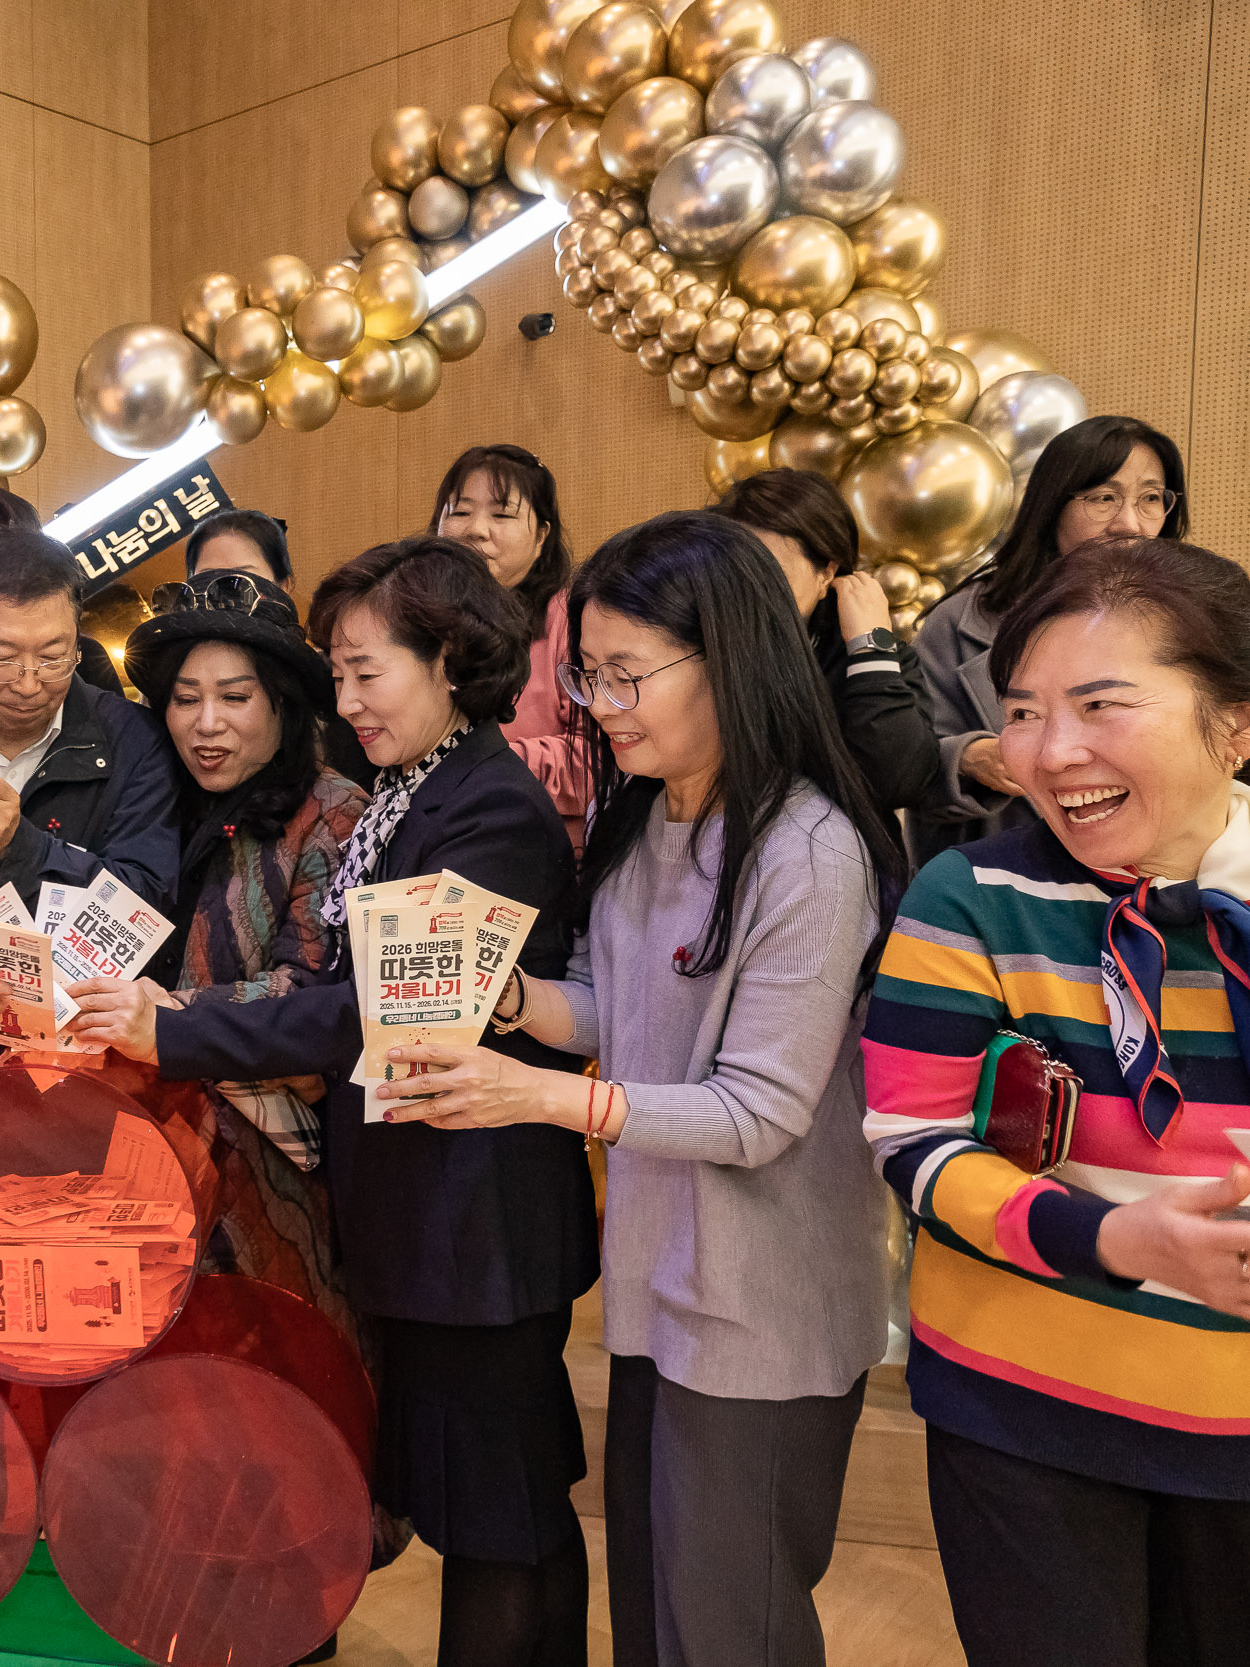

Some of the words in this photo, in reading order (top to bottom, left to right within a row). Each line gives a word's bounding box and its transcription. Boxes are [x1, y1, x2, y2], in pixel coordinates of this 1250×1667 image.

[75, 499, 181, 579] 나눔의
[173, 474, 220, 520] 날
[47, 911, 67, 921] 202
[87, 902, 110, 923] 2026
[109, 919, 145, 952] 희망온돌
[73, 910, 136, 969] 따뜻한
[381, 943, 412, 955] 2026
[415, 939, 463, 954] 희망온돌
[476, 927, 511, 951] 망온돌
[63, 928, 122, 978] 겨울나기
[380, 954, 464, 981] 따뜻한
[380, 979, 461, 1000] 겨울나기
